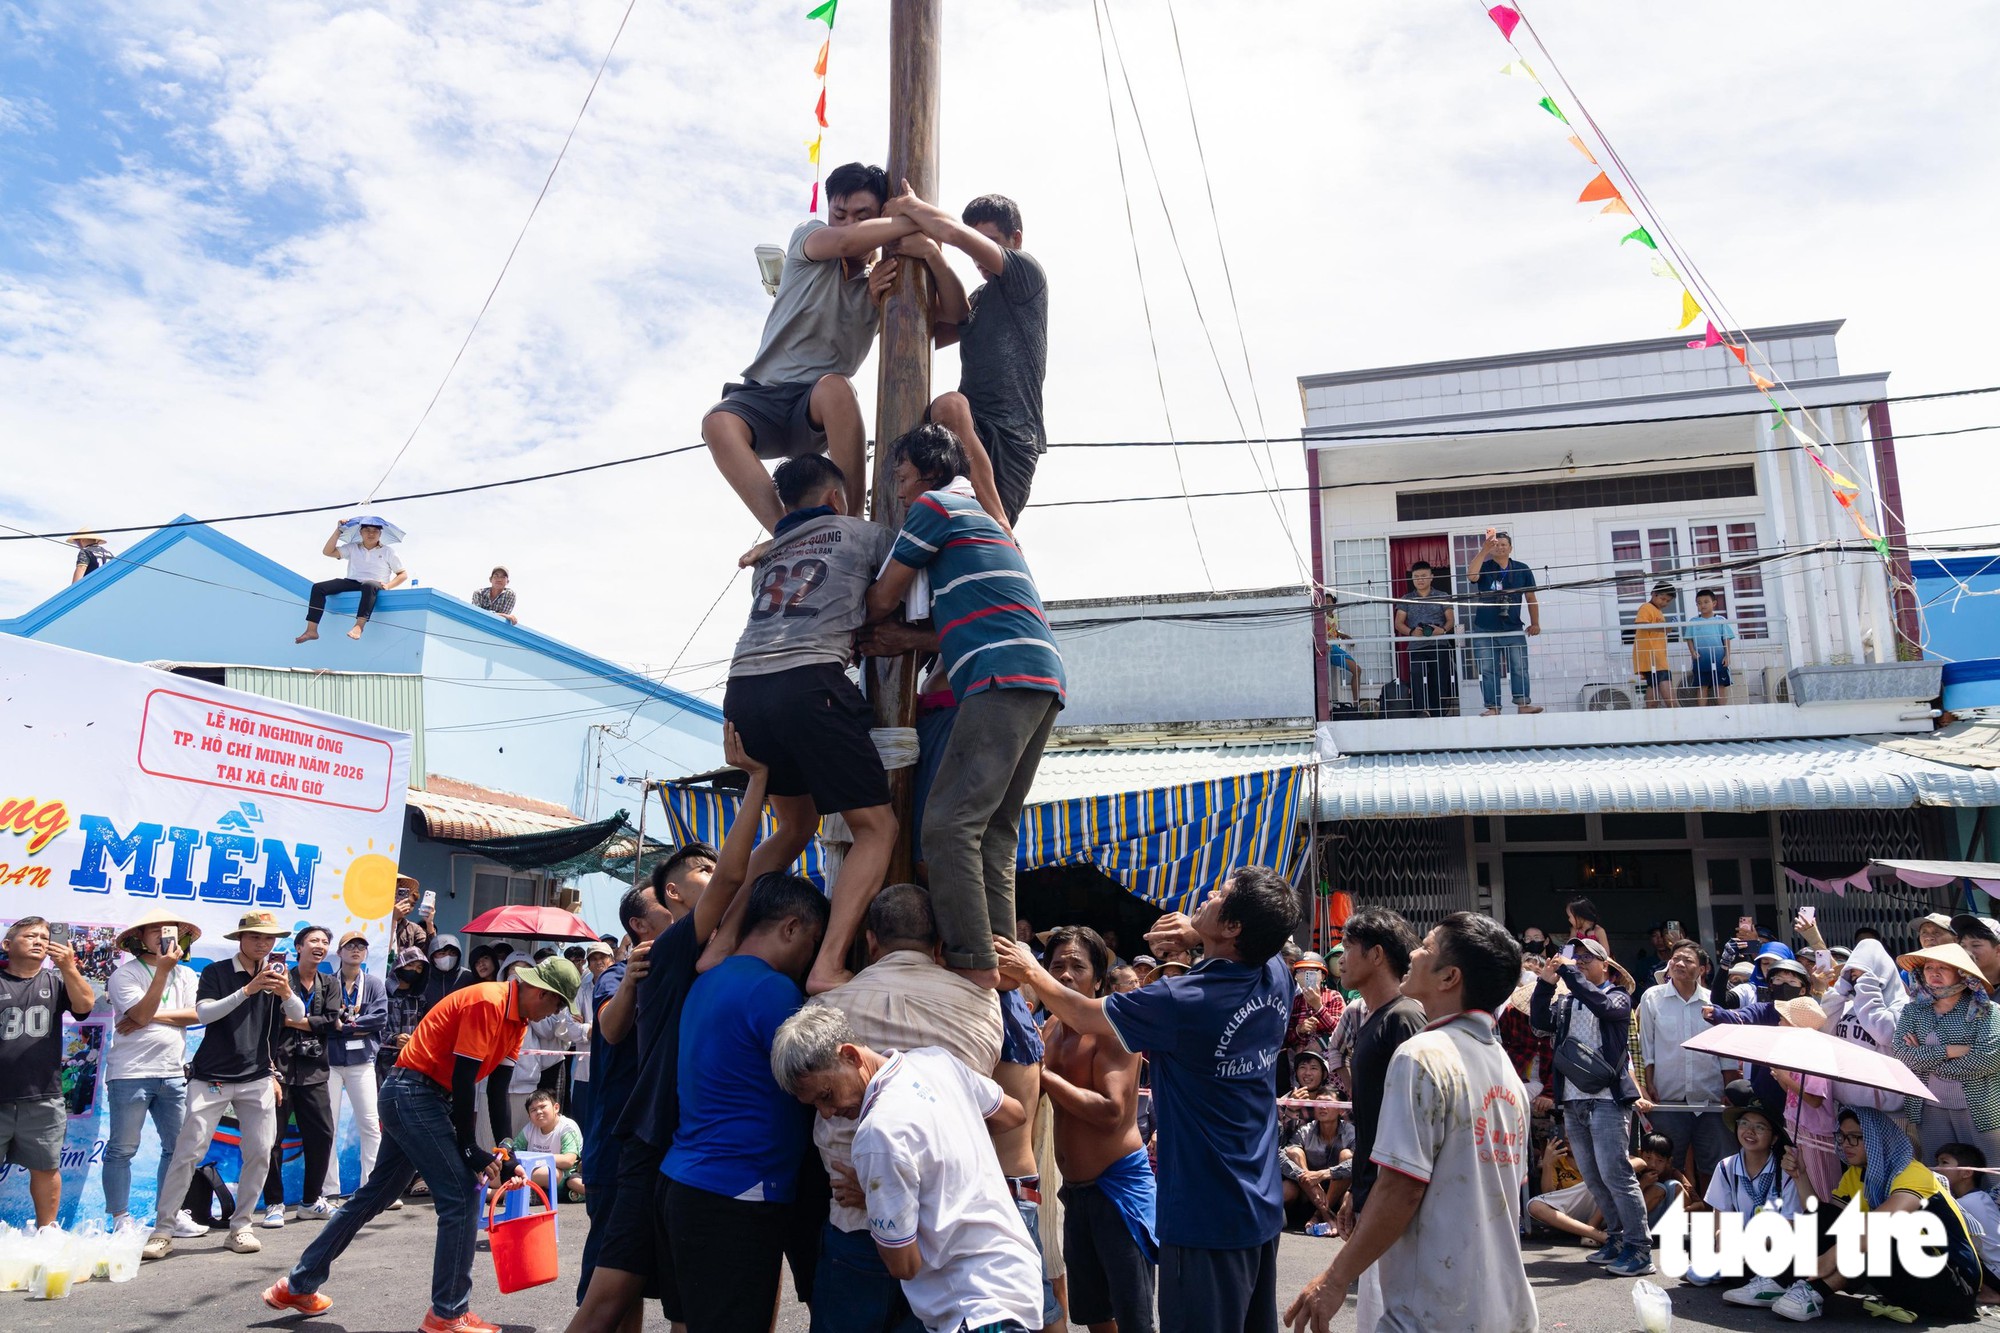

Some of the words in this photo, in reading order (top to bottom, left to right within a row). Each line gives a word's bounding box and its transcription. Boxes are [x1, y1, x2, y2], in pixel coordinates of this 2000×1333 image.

[750, 558, 829, 622] 82
[173, 730, 196, 748] TP.
[200, 733, 223, 753] HỒ
[226, 742, 253, 759] CHÍ
[255, 746, 297, 767] MINH
[298, 755, 331, 774] NĂM
[333, 763, 364, 780] 2026
[206, 709, 226, 729] LỄ
[229, 716, 256, 736] HỘI
[258, 723, 314, 748] NGHINH
[316, 734, 344, 754] ÔNG
[217, 764, 243, 782] TẠI
[245, 769, 266, 786] XÃ
[270, 770, 299, 791] CẦN
[301, 779, 324, 796] GIỜ
[69, 801, 322, 910] MIỀN
[0, 1004, 51, 1041] 80
[1214, 997, 1265, 1058] PICKLEBALL
[1215, 1058, 1254, 1078] Thảo
